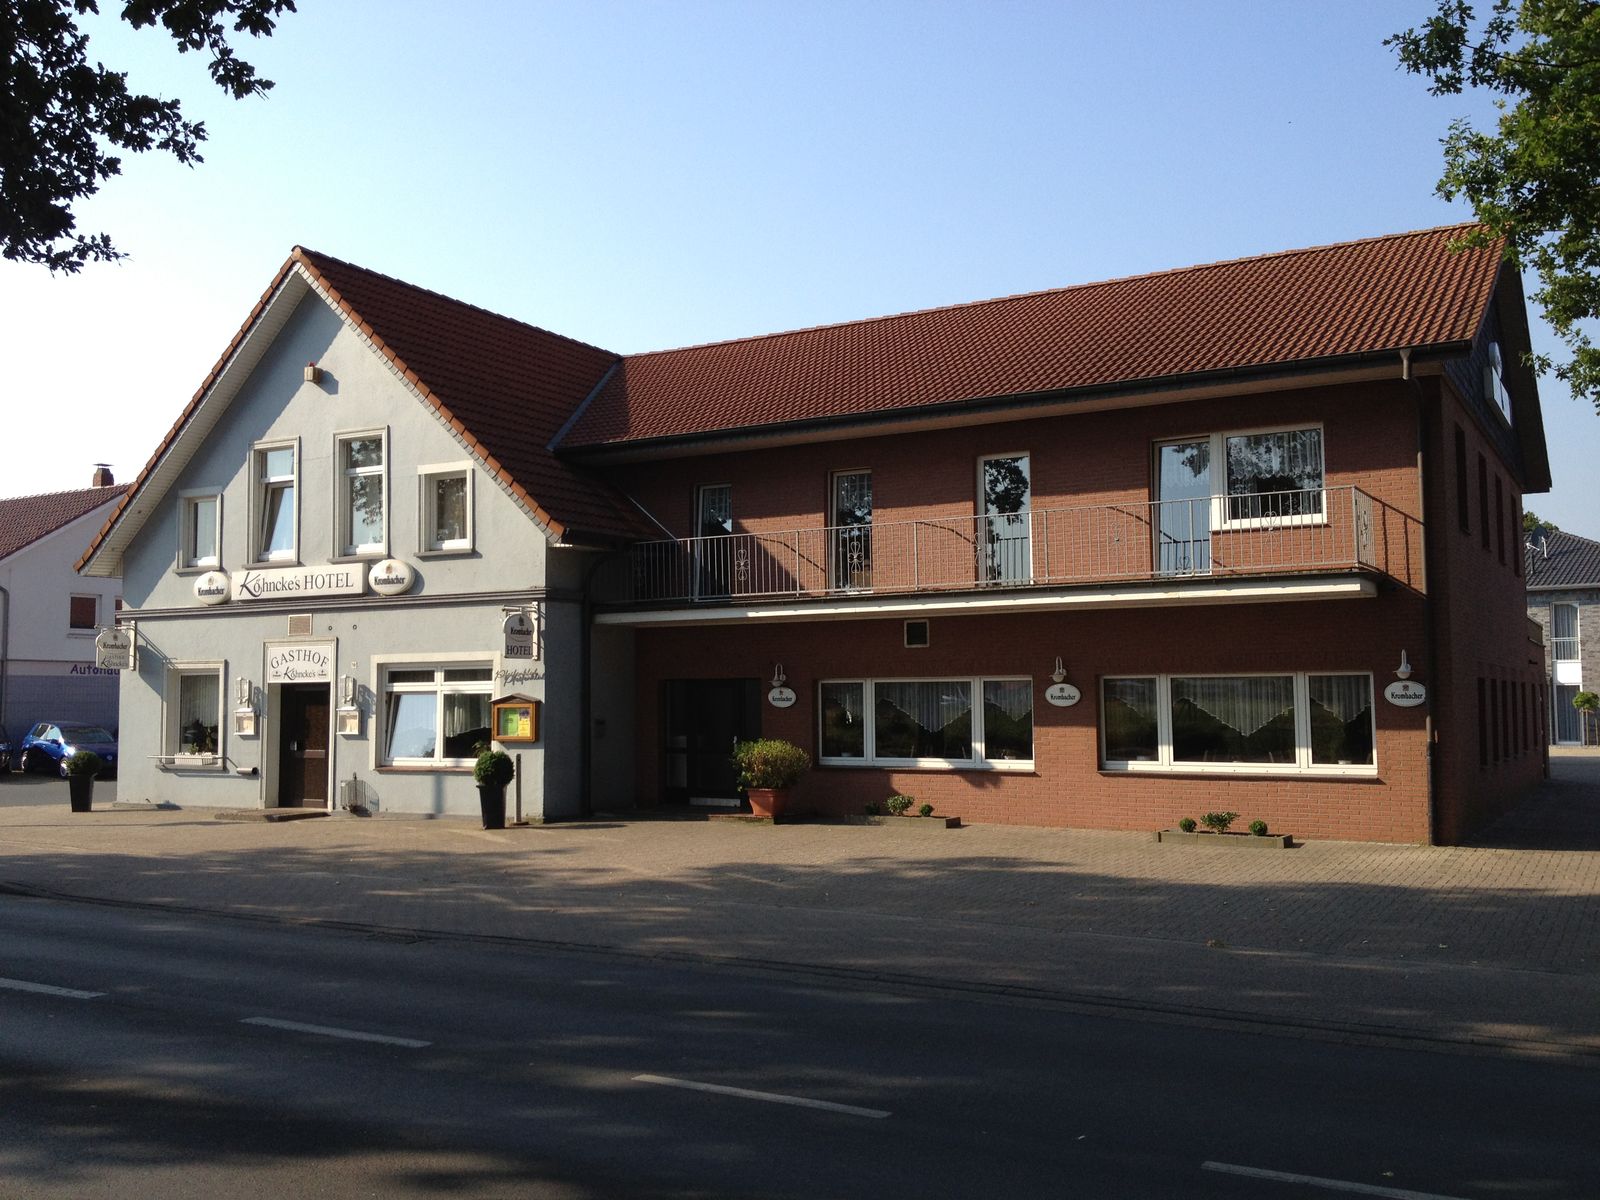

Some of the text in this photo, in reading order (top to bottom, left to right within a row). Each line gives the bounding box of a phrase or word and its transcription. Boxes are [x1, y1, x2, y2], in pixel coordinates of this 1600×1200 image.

[239, 571, 354, 597] Köhncke's HOTEL
[374, 575, 405, 585] Krombacher
[197, 586, 225, 596] Krombacher
[506, 645, 532, 656] HOTEL
[270, 649, 330, 669] GASTHOF
[1050, 693, 1077, 701] Krombacher
[1390, 691, 1423, 700] Krombacher
